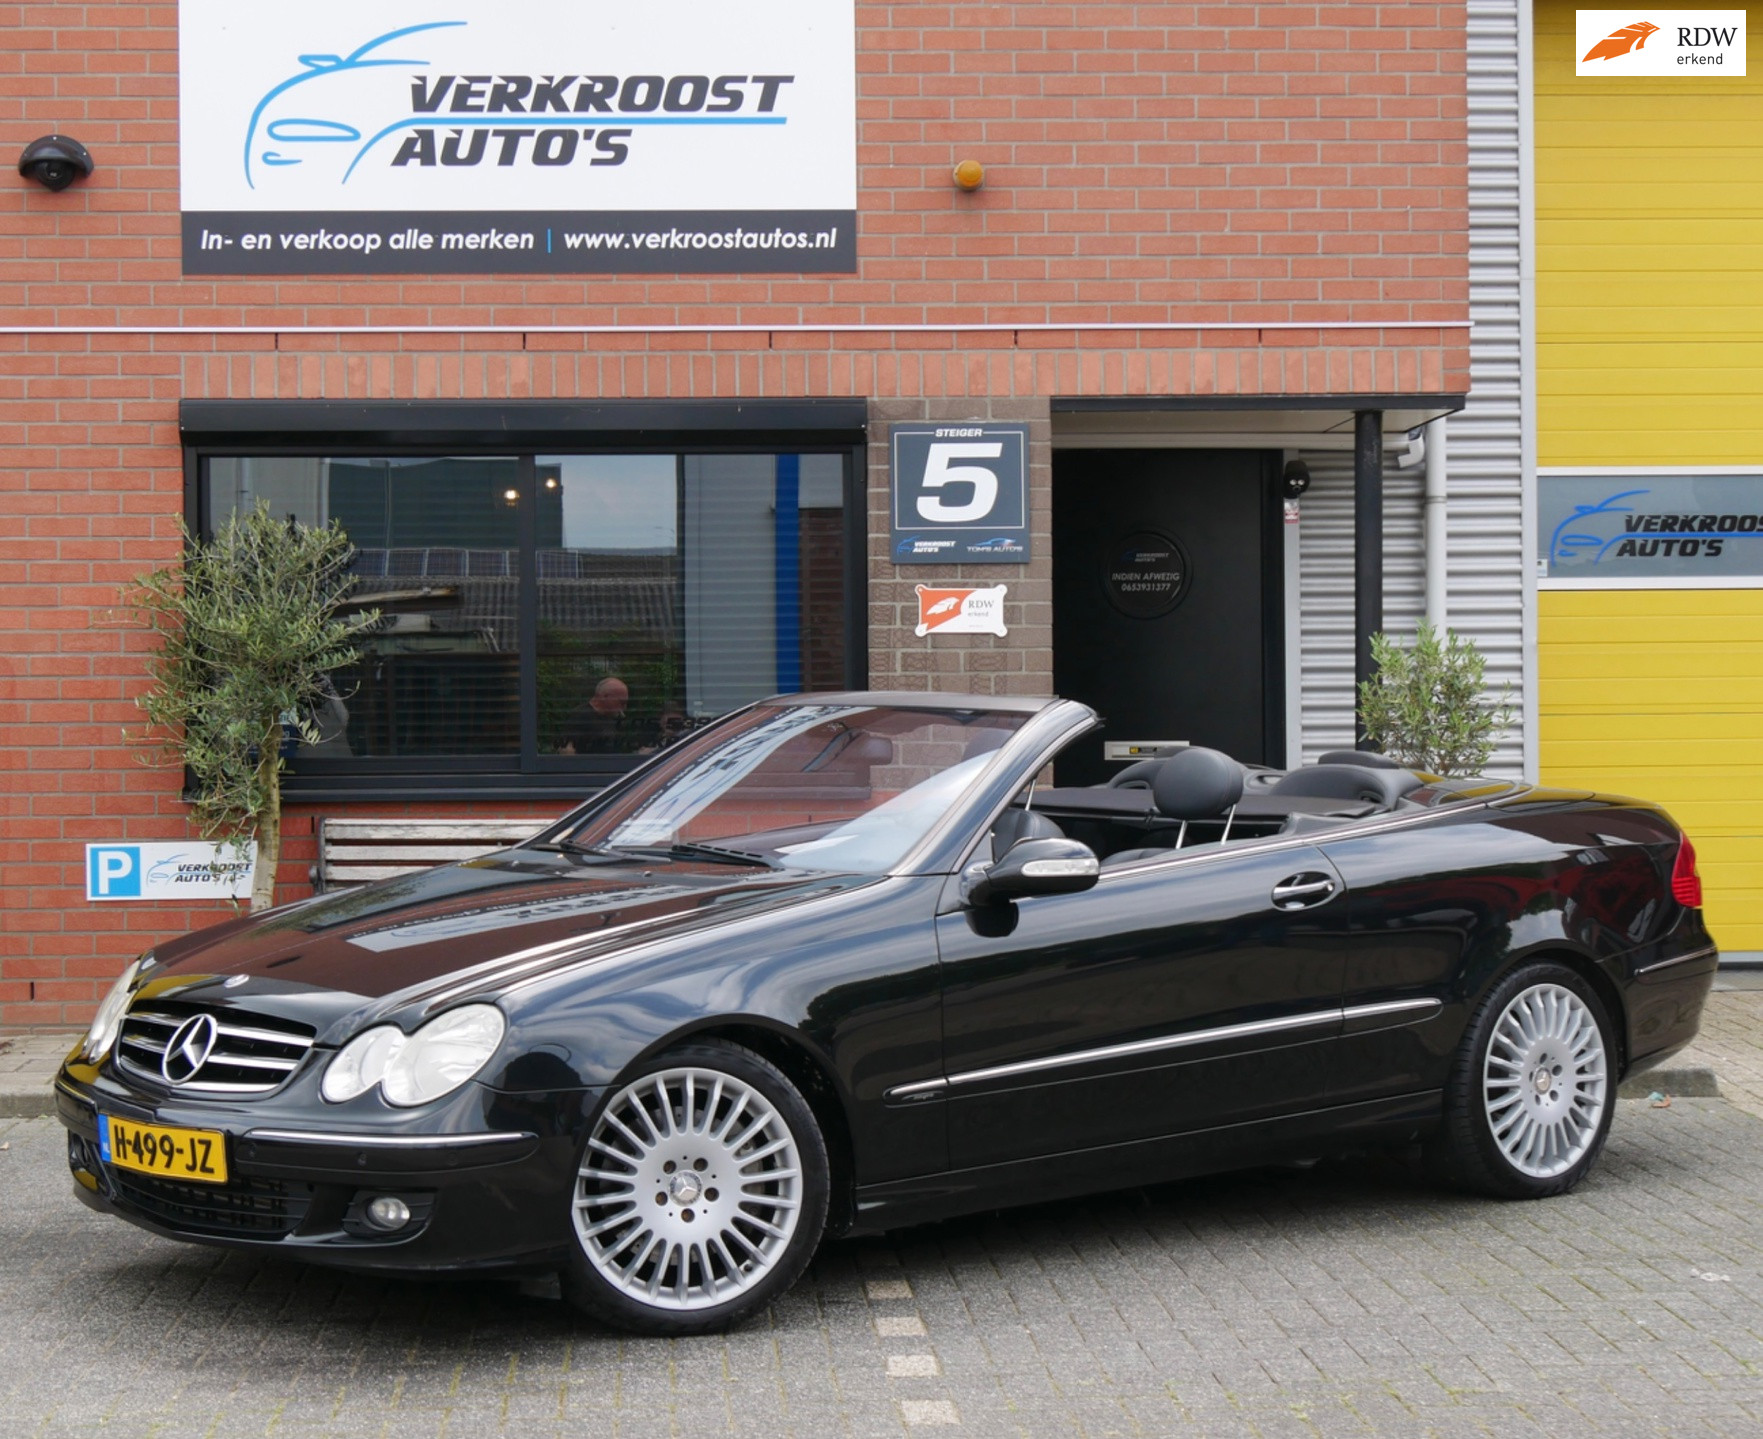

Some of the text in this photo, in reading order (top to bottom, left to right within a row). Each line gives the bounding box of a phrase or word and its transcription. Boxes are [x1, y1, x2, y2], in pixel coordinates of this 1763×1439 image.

[410, 75, 795, 113] VERKROOST
[390, 128, 632, 166] AUTO'S
[200, 228, 837, 255] In- en verkoop alle merken www.verkroostautos.nl
[935, 428, 983, 437] STEIGER
[916, 443, 1003, 522] 5
[1616, 539, 1724, 557] AUTO'S
[968, 600, 994, 608] RDW
[98, 851, 132, 894] P
[114, 1125, 215, 1174] H-499-JZ
